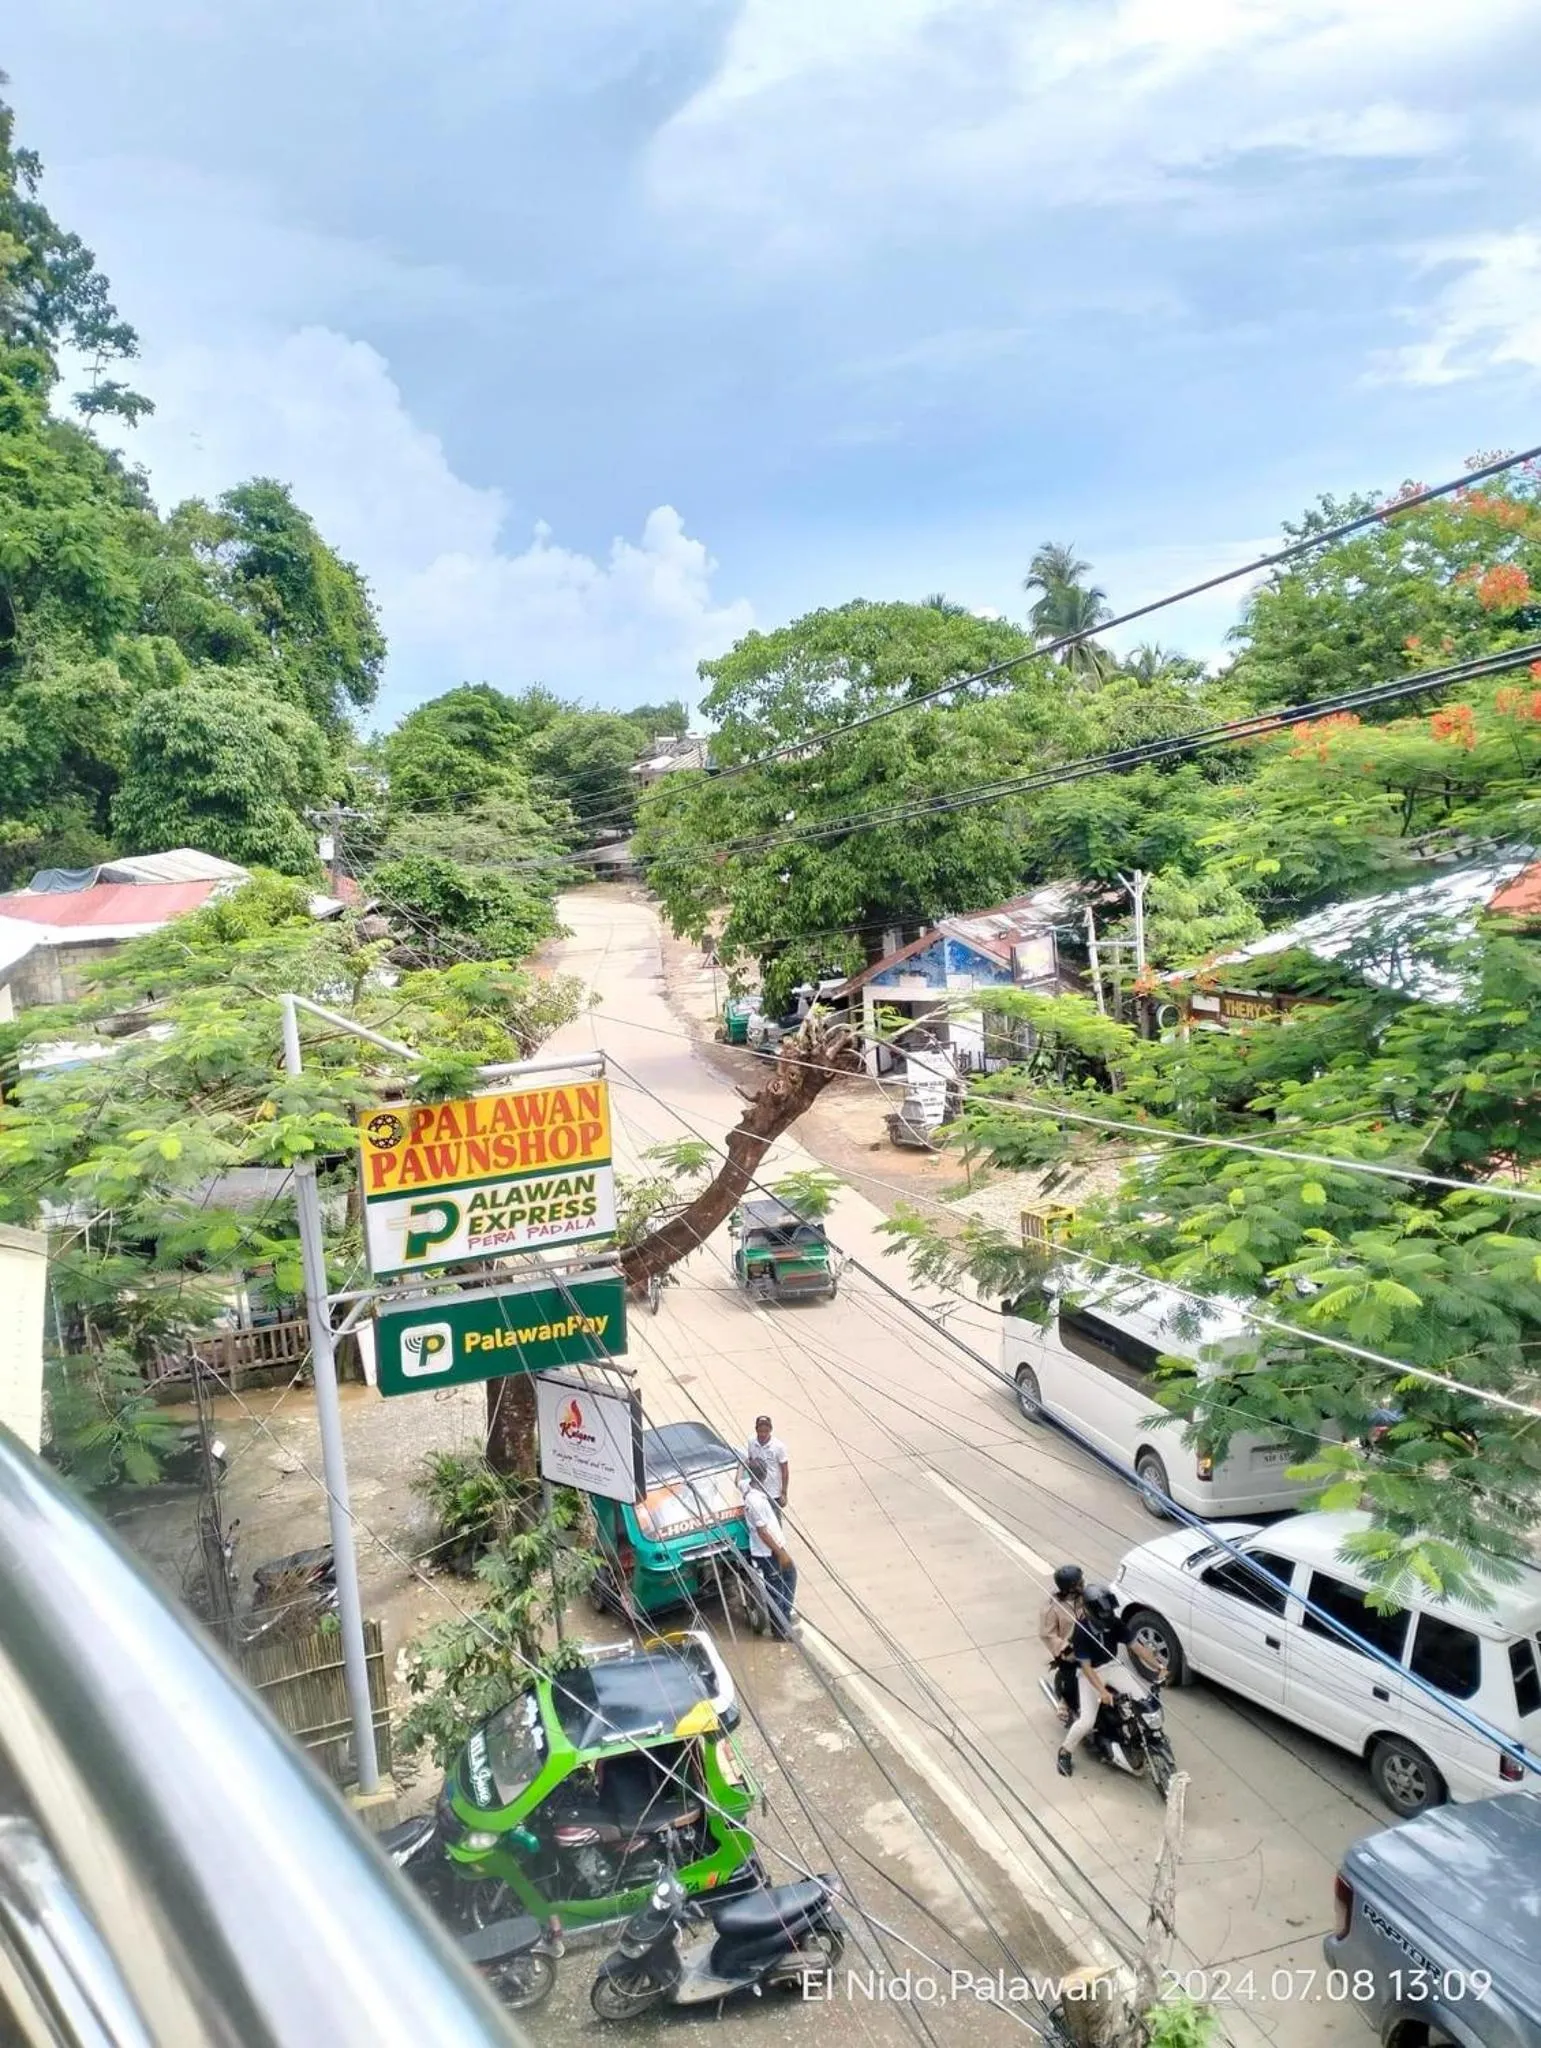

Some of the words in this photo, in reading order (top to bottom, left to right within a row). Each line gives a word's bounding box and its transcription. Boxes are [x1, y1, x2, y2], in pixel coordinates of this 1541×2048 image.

[1224, 999, 1272, 1018] THERY'S
[409, 1084, 601, 1145] PALAWAN
[370, 1121, 603, 1188] PAWNSHOP
[467, 1174, 595, 1213] ALAWAN
[467, 1231, 517, 1250] PERA
[527, 1217, 597, 1240] PADALA
[468, 1196, 597, 1236] EXPRESS
[465, 1315, 609, 1353] PalawanPay
[1362, 1901, 1441, 1980] RAPTOR
